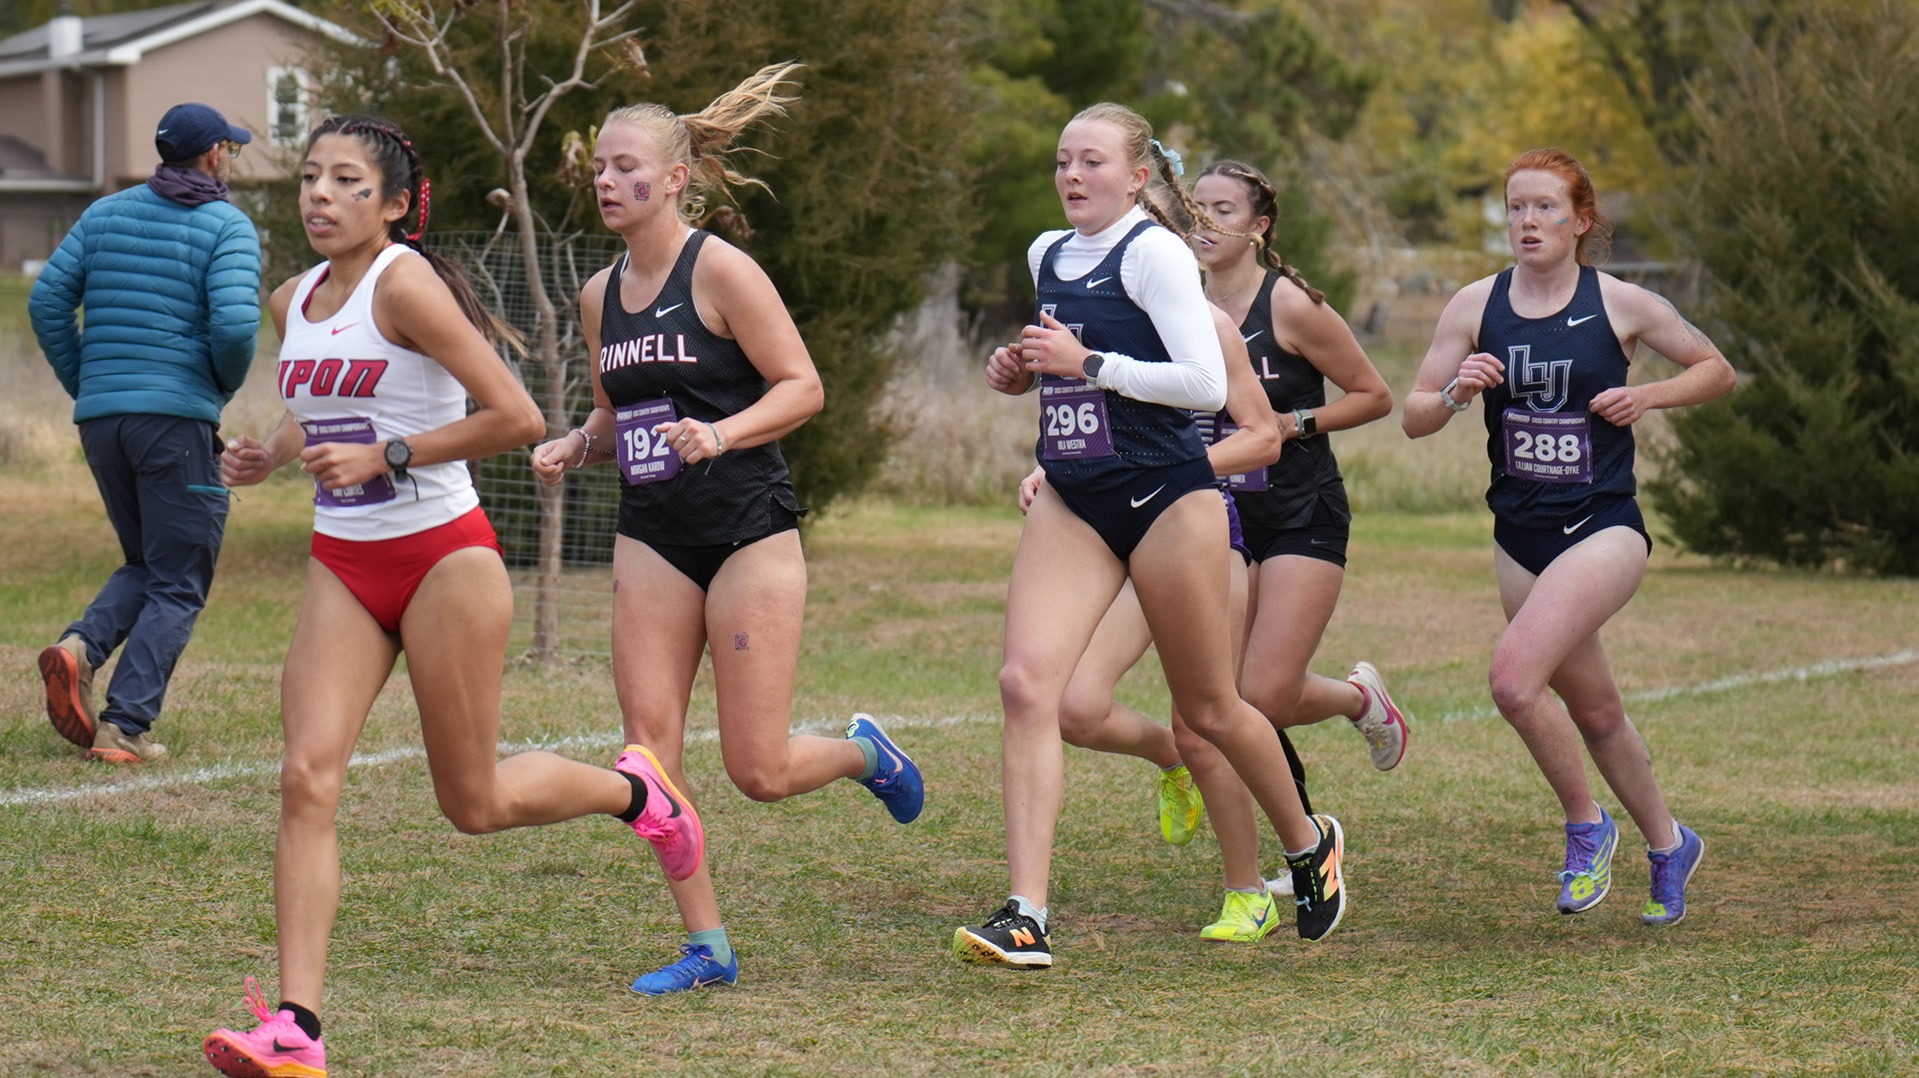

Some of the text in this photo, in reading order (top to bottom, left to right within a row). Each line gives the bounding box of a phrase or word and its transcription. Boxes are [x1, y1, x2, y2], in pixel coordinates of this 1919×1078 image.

[1508, 344, 1574, 413] LU
[1046, 402, 1099, 436] 296
[623, 424, 670, 462] 192
[1514, 431, 1581, 462] 288
[1515, 460, 1580, 474] LILLIAN COURTNAGE-DYKE
[1009, 926, 1036, 948] N
